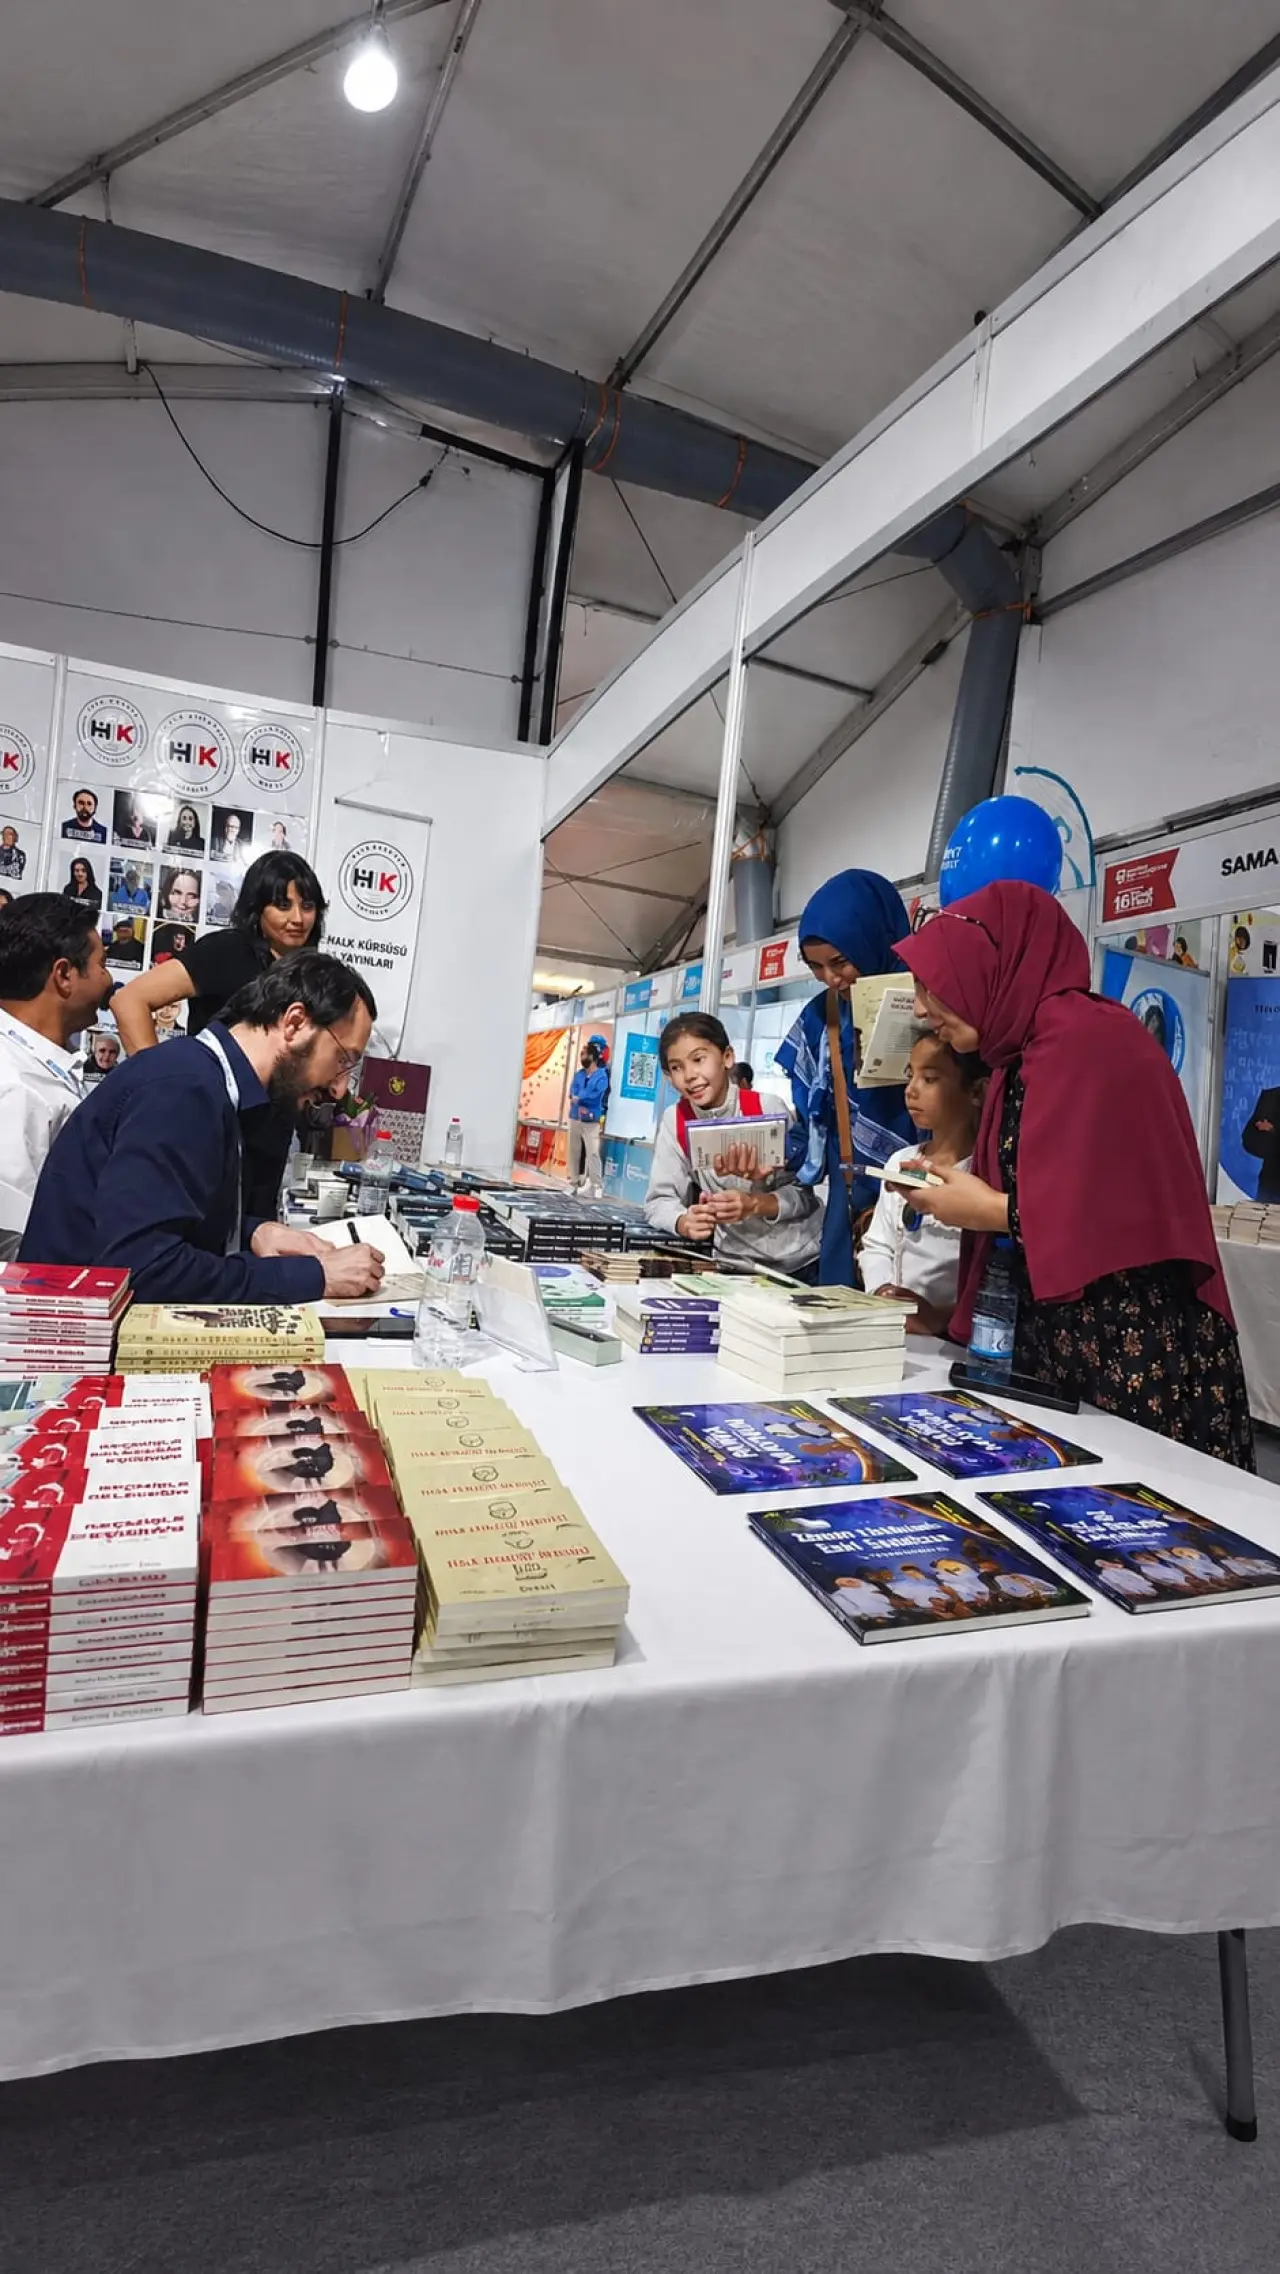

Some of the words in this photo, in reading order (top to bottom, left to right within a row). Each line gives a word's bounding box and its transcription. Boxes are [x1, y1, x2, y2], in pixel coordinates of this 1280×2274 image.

[1221, 848, 1279, 877] SAMA
[326, 934, 355, 949] HALK
[340, 952, 394, 970] YAYINLARI
